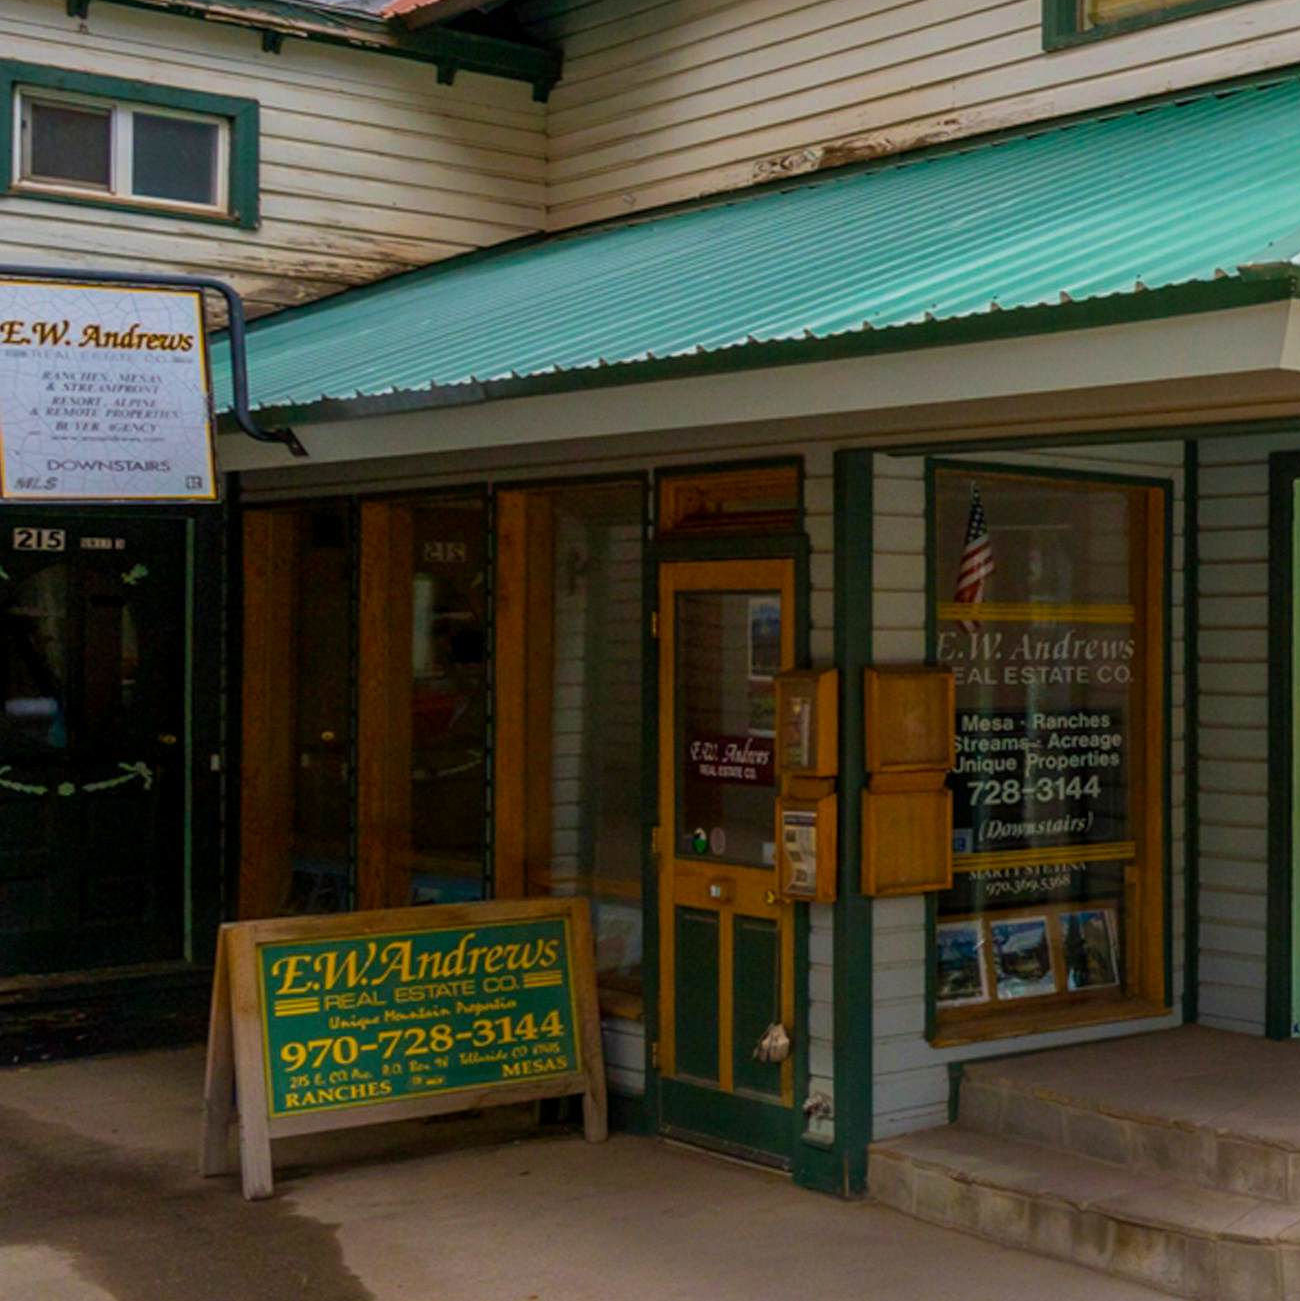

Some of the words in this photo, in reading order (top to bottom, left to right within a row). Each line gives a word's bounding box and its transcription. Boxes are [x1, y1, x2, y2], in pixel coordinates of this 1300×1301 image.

[0, 320, 71, 347] E.W.
[78, 323, 194, 352] Andrews
[47, 459, 171, 473] DOWNSTAIRS
[17, 530, 61, 548] 215
[935, 630, 1003, 662] E.W.
[1008, 630, 1136, 661] Andrews
[952, 665, 998, 685] EAL
[1003, 665, 1090, 685] ESTATE
[1096, 664, 1135, 684] CO.
[961, 714, 1015, 733] Mesa
[1032, 712, 1111, 730] Ranches
[721, 736, 771, 765] Andrews
[1047, 731, 1123, 751] Acreage
[699, 763, 718, 777] REAL
[718, 765, 743, 779] ESTATE
[1026, 750, 1121, 772] Properties
[966, 774, 1102, 807] 728-3144
[977, 810, 1095, 843] (Downstairs)
[371, 932, 560, 986] Andrews
[324, 991, 387, 1012] REAL
[394, 979, 477, 1004] ESTATE
[482, 975, 520, 993] CO.
[328, 1015, 381, 1031] Unique
[384, 1007, 451, 1023] Mountain
[279, 1009, 566, 1073] 970-728-3144
[500, 1056, 568, 1078] MESAS
[284, 1080, 394, 1109] RANCHES
